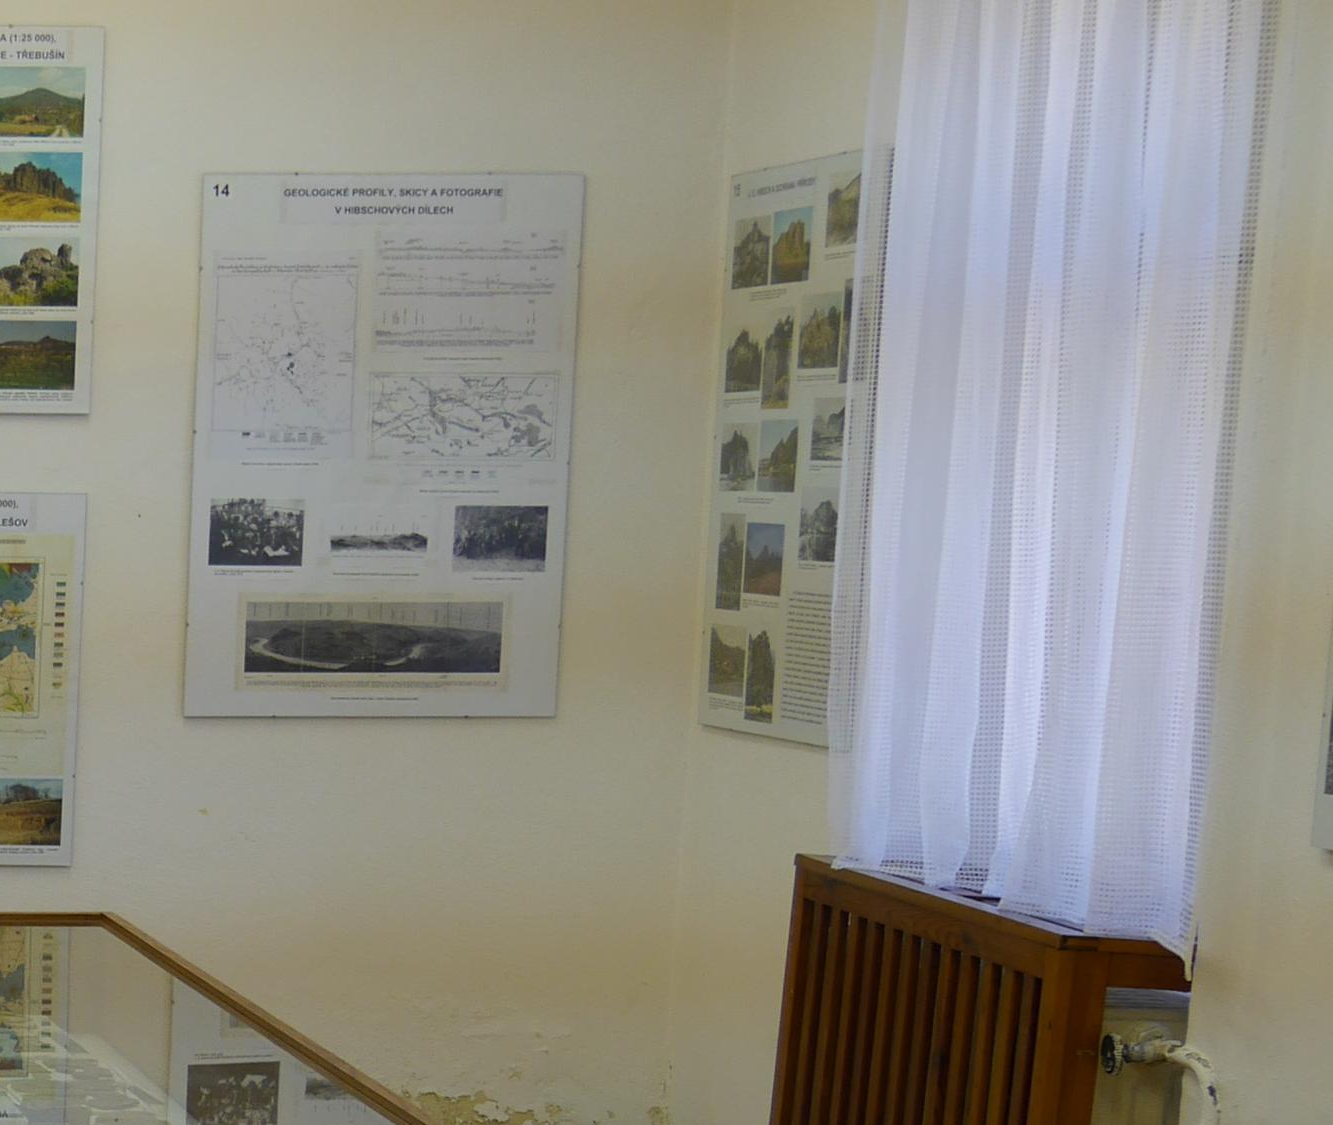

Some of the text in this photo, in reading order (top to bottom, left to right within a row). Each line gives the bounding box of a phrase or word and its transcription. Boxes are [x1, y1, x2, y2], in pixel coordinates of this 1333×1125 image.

[15, 48, 65, 60] TŘEBUŠÍN
[212, 184, 230, 197] 14
[284, 186, 349, 197] GEOLOGICKÉ
[399, 188, 428, 197] SKICY
[430, 188, 437, 197] A
[440, 188, 503, 198] FOTOGRAFIE
[335, 203, 454, 215] V HIBSCHOVÝCH DÍLECH
